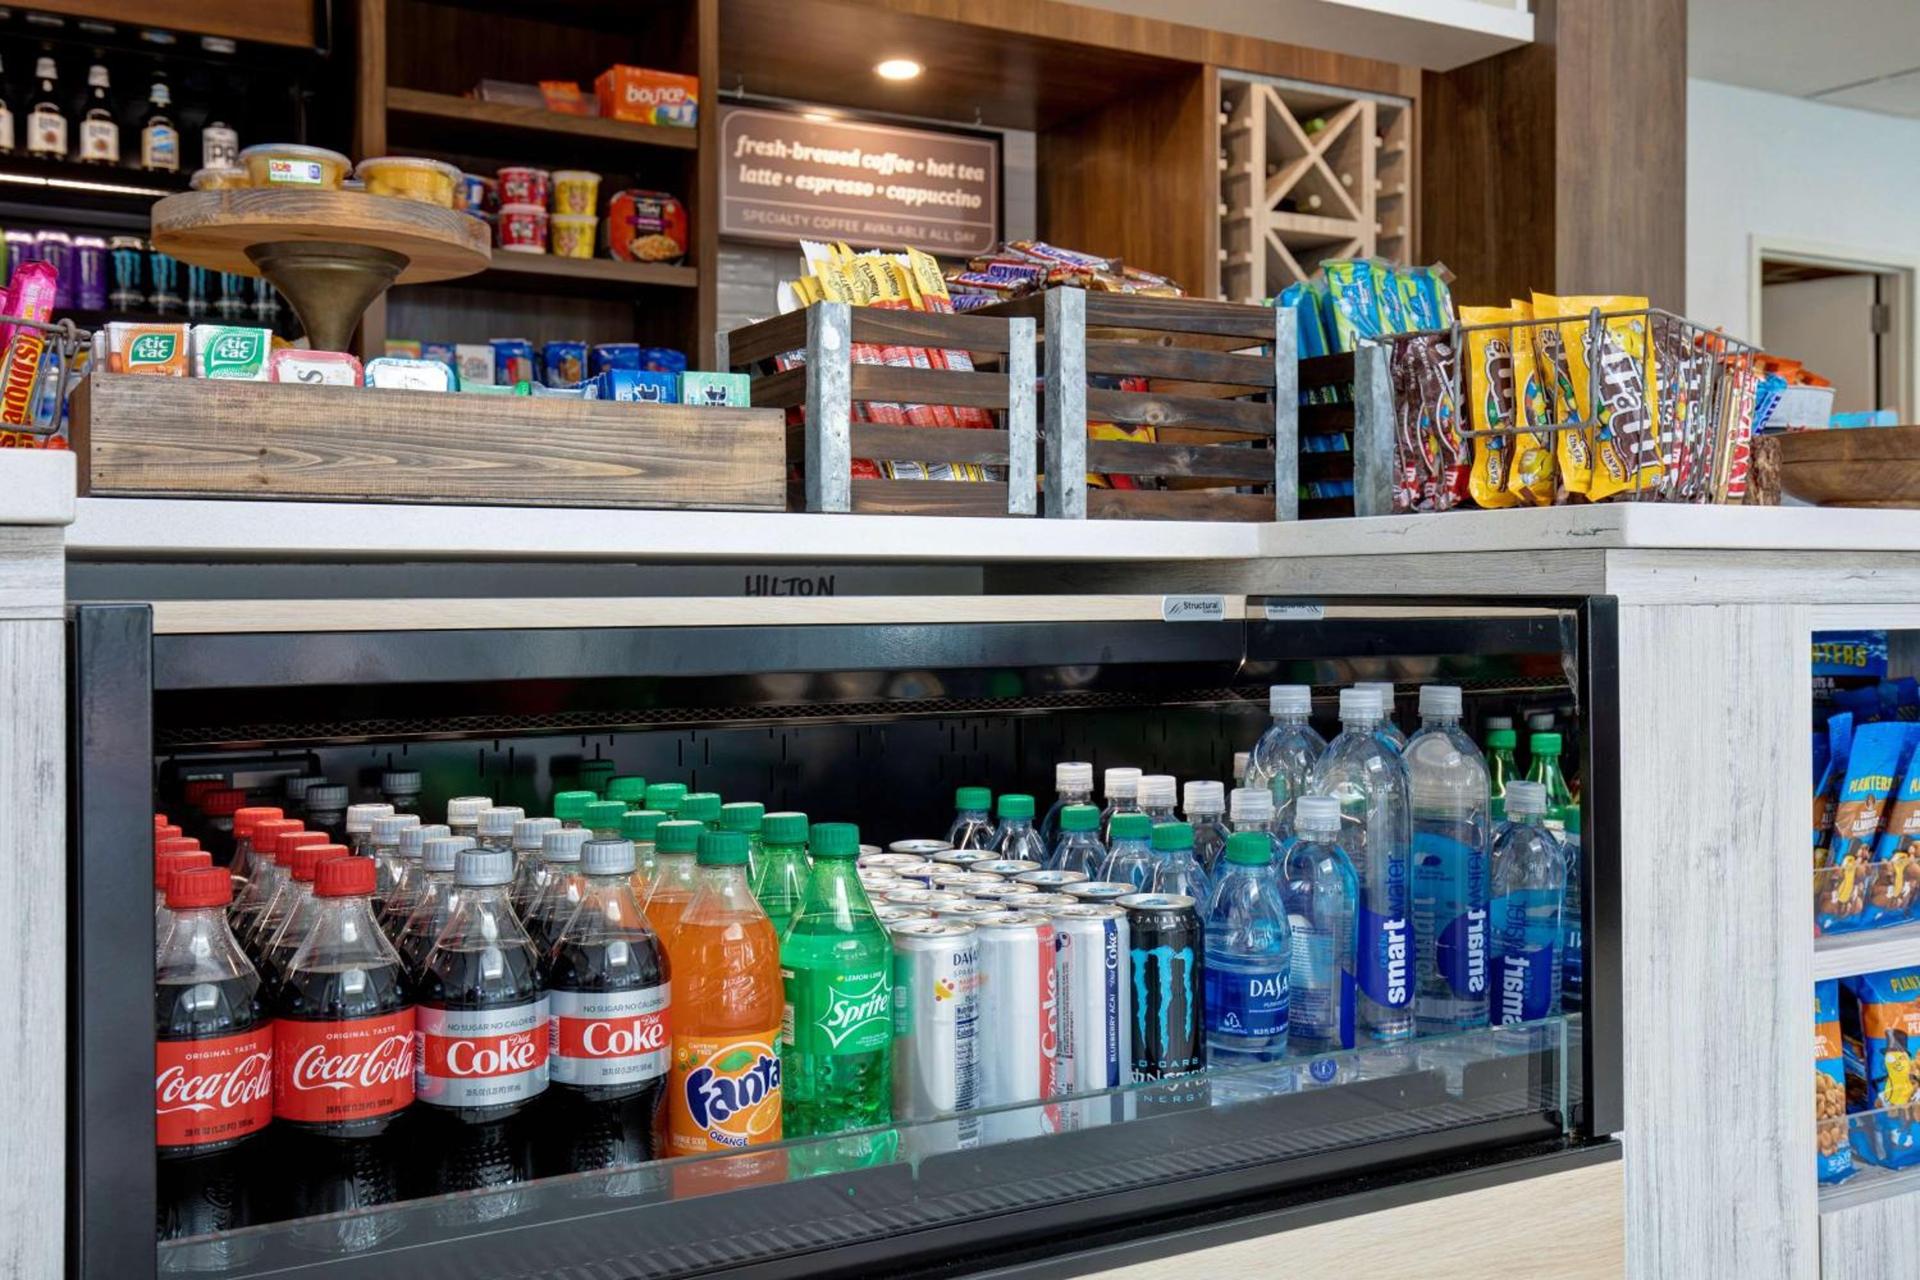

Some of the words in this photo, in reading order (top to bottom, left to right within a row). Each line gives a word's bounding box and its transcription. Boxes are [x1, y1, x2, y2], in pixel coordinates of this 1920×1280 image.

[625, 82, 686, 105] bounce
[734, 134, 861, 168] fresh-brewed
[861, 153, 915, 177] coffee
[926, 157, 955, 178] hot
[957, 164, 985, 183] tea
[739, 163, 782, 187] latte
[795, 175, 875, 198] espresso
[886, 184, 983, 209] cappuccino
[742, 208, 811, 228] SPECIALTY
[813, 216, 860, 233] COFFEE
[863, 221, 926, 240] AVAILABLE
[928, 229, 951, 241] ALL
[954, 232, 977, 244] DAY
[138, 348, 169, 359] tac
[144, 337, 171, 349] tic
[220, 348, 250, 359] tac
[226, 337, 253, 349] tic
[744, 574, 836, 597] HILTON
[1183, 601, 1219, 611] Structural
[1105, 931, 1117, 971] Coke
[1383, 918, 1406, 1004] smart
[584, 1005, 595, 1013] NO
[597, 1004, 624, 1013] SUGAR
[625, 1002, 638, 1011] NO
[828, 993, 888, 1028] Sprite
[326, 1030, 370, 1041] ORIGINAL
[373, 1025, 396, 1036] TASTE
[448, 1023, 460, 1032] NO
[461, 1022, 489, 1032] SUGAR
[490, 1021, 504, 1030] NO
[583, 1020, 665, 1056] Coke
[185, 1048, 231, 1061] ORIGINAL
[234, 1042, 257, 1054] TASTE
[293, 1031, 415, 1090] Coca-Cola
[447, 1040, 535, 1075] Coke
[156, 1048, 273, 1113] Coca-Cola
[685, 1053, 781, 1130] Fanta
[709, 1130, 749, 1147] ORANGE
